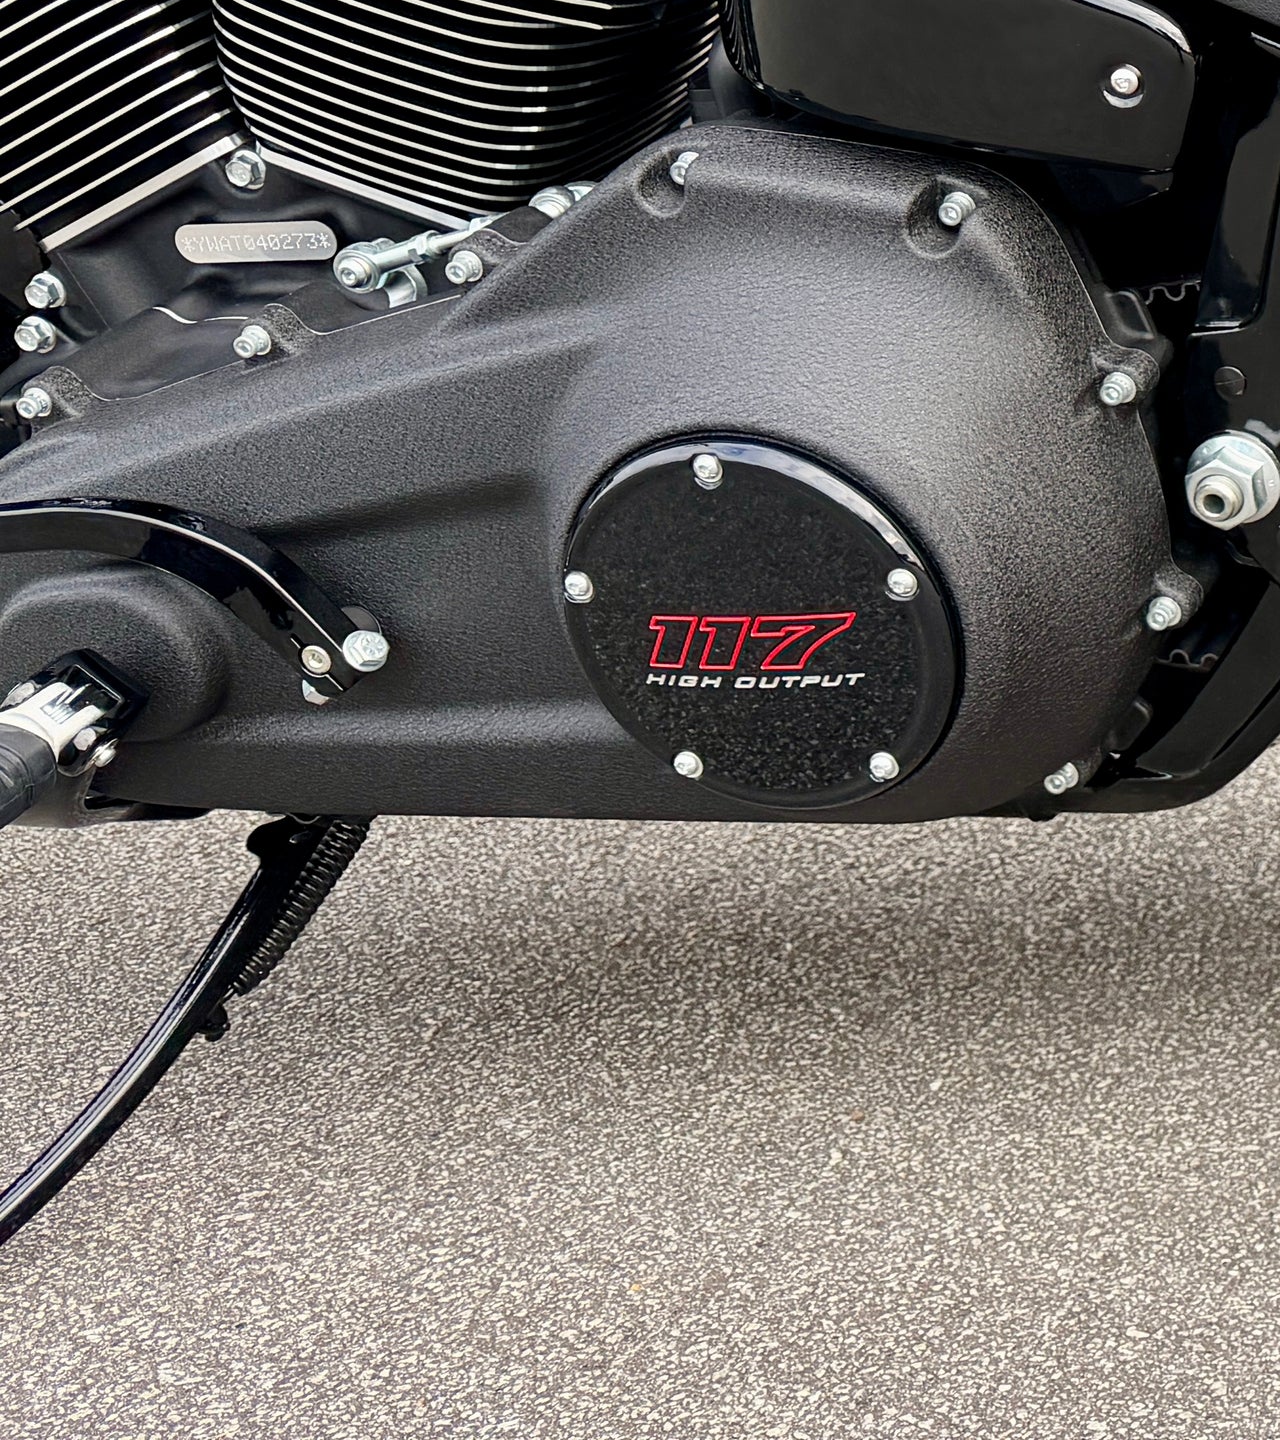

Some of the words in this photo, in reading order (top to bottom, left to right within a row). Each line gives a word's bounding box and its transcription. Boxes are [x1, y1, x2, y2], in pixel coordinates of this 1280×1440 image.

[649, 612, 857, 670] 117
[646, 673, 723, 689] HIGH
[734, 672, 866, 689] OUTPUT
